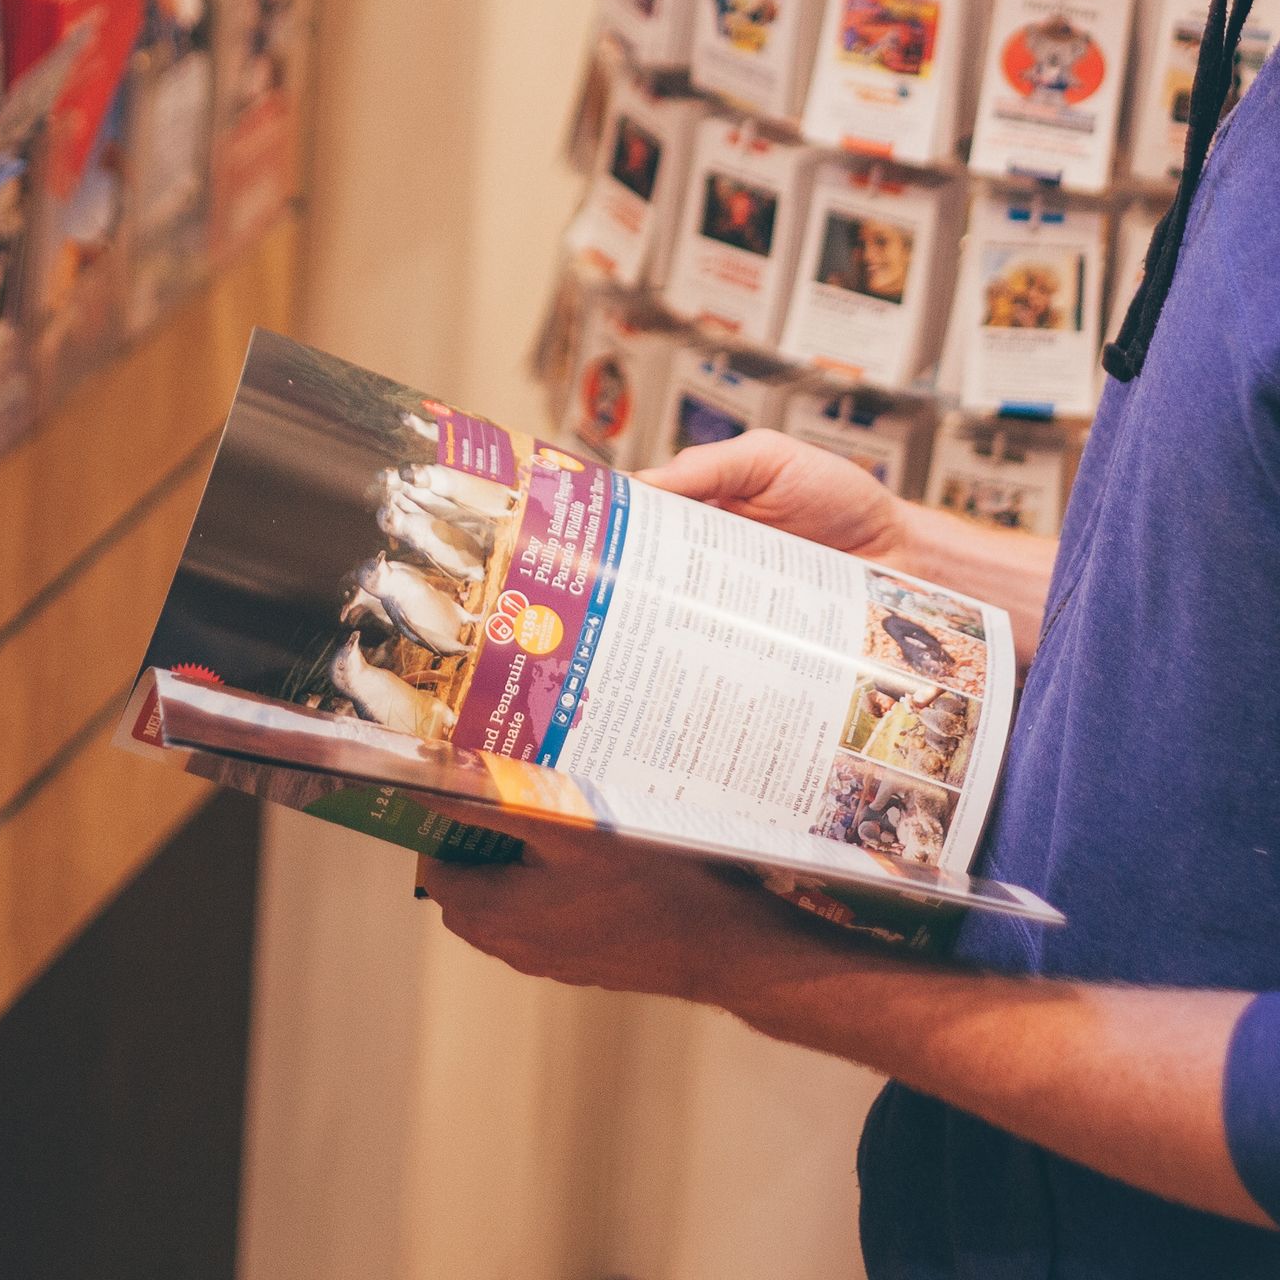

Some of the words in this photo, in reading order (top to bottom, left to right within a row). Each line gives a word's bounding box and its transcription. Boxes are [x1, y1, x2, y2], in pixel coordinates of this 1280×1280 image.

[547, 492, 569, 537] Island
[522, 535, 544, 566] Day
[534, 537, 562, 585] Phillip
[551, 542, 577, 591] Parade
[564, 500, 585, 540] Wildlife
[569, 513, 601, 596] Conservation
[611, 696, 634, 734] Phillip
[626, 652, 646, 694] Island
[638, 606, 659, 652] Penguin
[613, 637, 636, 684] Moonlit
[490, 653, 526, 726] Penguin
[569, 724, 594, 775] ordinary
[588, 696, 603, 721] day,
[598, 631, 623, 696] experience
[613, 685, 620, 699] at
[590, 699, 616, 756] wallabies
[623, 739, 634, 758] YOU
[631, 698, 649, 738] PROVIDE
[649, 730, 668, 767] OPTIONS
[668, 742, 683, 768] Penguin
[678, 727, 689, 742] Plus
[686, 745, 702, 774] Penguins
[722, 755, 738, 787] Aboriginal
[734, 727, 748, 754] Heritage
[757, 778, 770, 799] Guided
[765, 754, 779, 778] Ranger
[800, 766, 814, 793] Antarctic
[376, 796, 390, 808] 2
[801, 788, 815, 815] Nobbies
